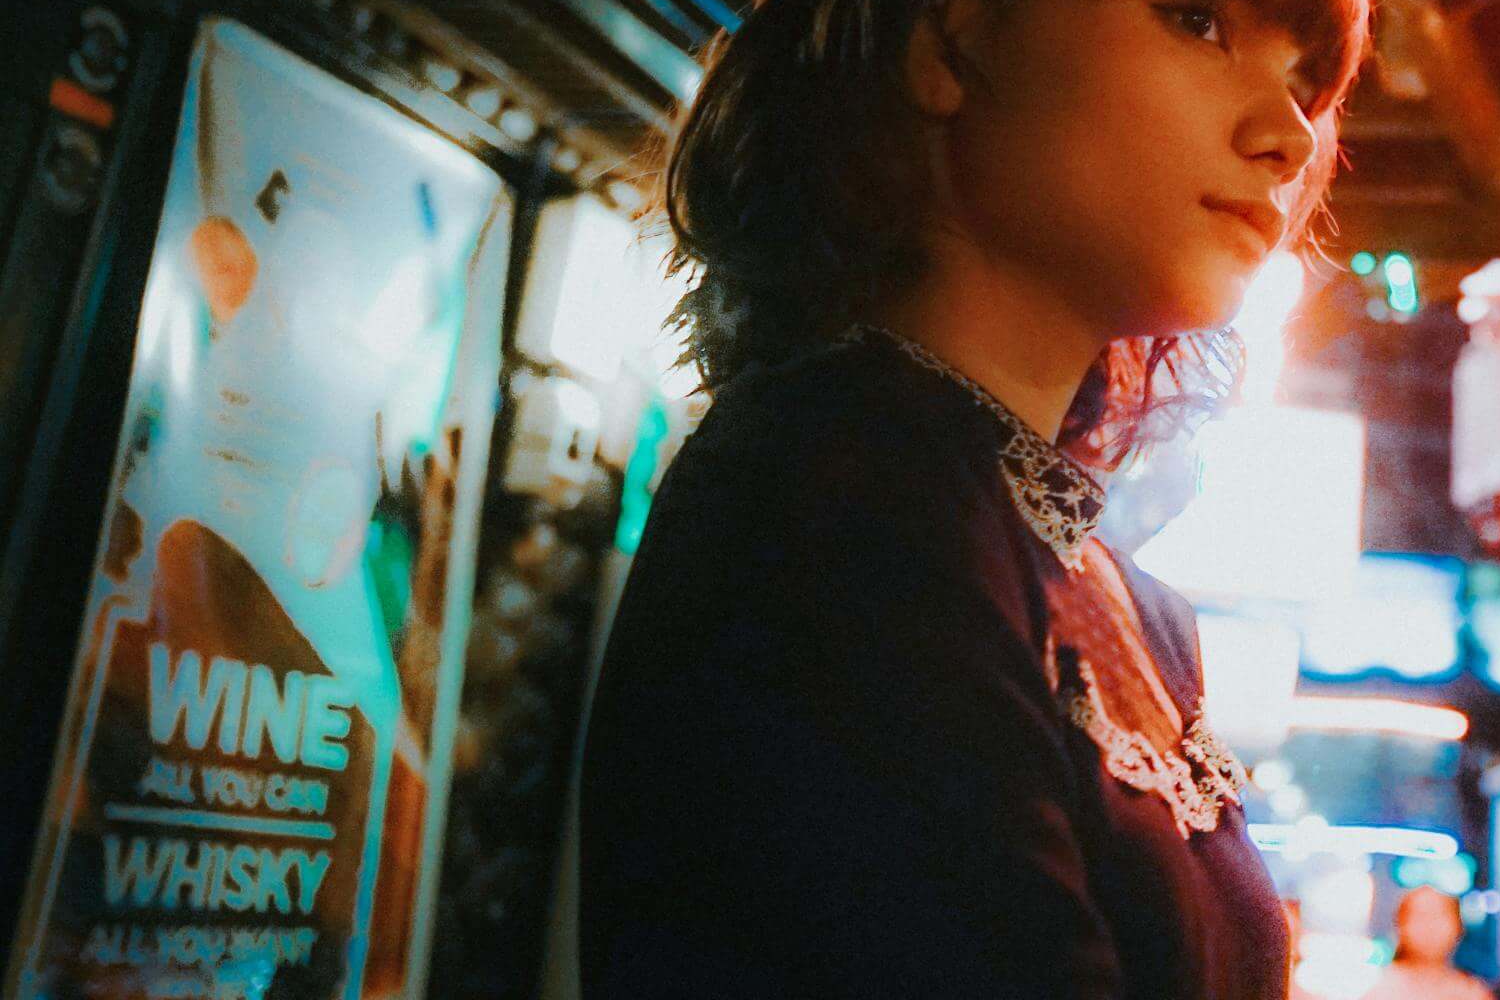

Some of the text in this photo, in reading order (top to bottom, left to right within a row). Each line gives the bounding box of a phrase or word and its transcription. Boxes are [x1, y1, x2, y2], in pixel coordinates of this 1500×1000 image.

[150, 643, 350, 770] WINE
[202, 766, 262, 808] YOU
[106, 836, 332, 914] WHISKY
